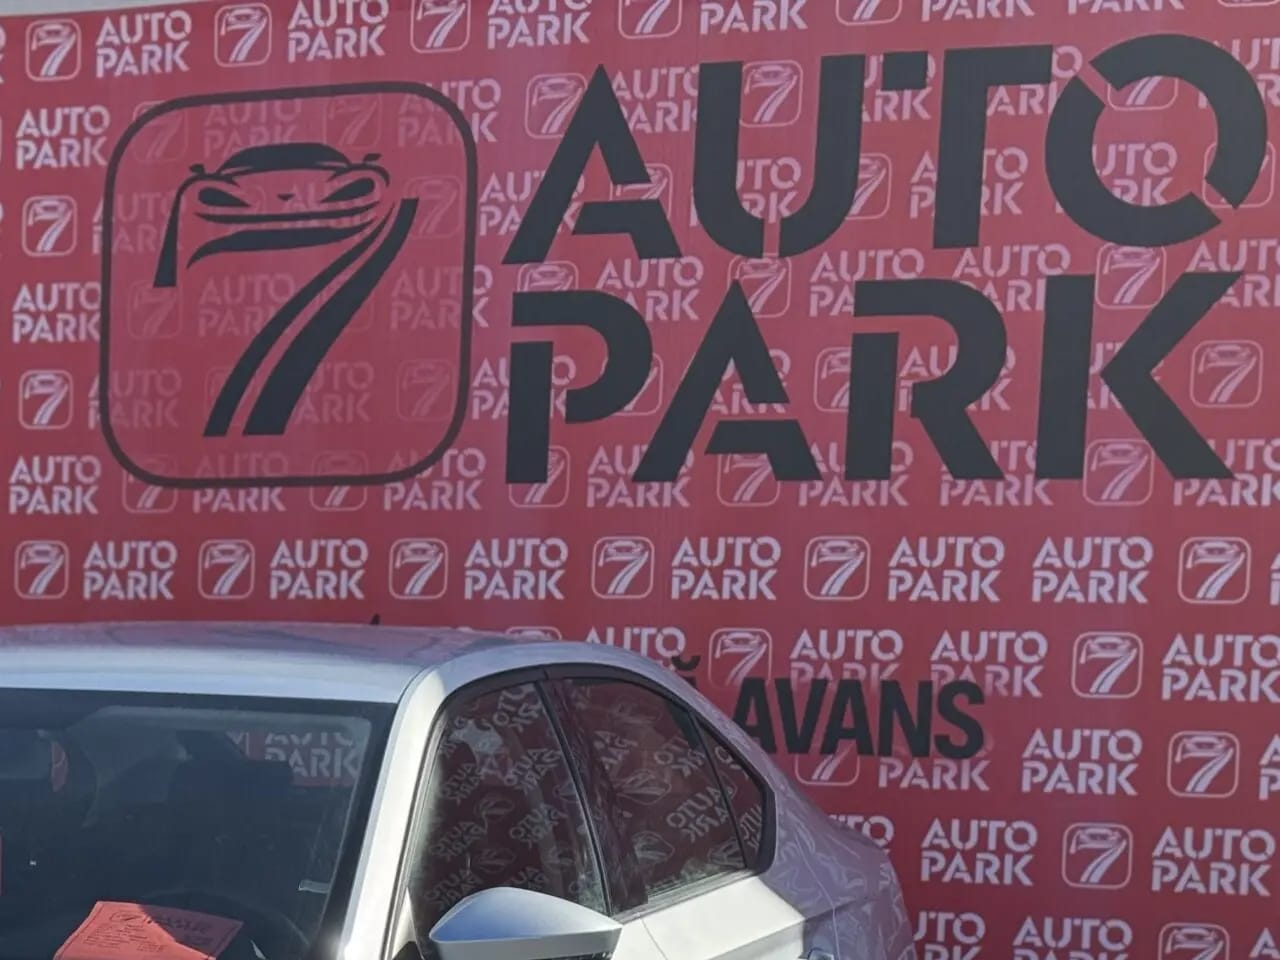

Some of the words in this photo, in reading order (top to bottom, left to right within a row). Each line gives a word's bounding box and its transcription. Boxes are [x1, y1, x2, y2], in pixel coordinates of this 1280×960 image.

[96, 11, 191, 46] AUTO
[288, 0, 388, 30] AUTO
[488, 12, 590, 49] PARK
[700, 0, 807, 34] PARK
[96, 41, 189, 78] PARK
[288, 25, 385, 63] PARK
[16, 105, 110, 140] AUTO
[16, 136, 107, 170] PARK
[502, 33, 1268, 264] AUTO
[1093, 141, 1177, 177] UTO
[595, 256, 703, 290] AUTO
[810, 249, 924, 282] AUTO
[952, 244, 1070, 278] AUTO
[12, 282, 101, 312] AUTO
[13, 312, 100, 343] PARK
[506, 270, 1244, 483] PARK
[9, 456, 101, 484] AUTO
[9, 485, 98, 514] PARK
[194, 488, 285, 512] PARK
[384, 480, 481, 510] PARK
[587, 477, 690, 507] PARK
[799, 475, 908, 506] PARK
[940, 474, 1053, 506] PARK
[83, 541, 177, 571] AUTO
[270, 538, 368, 568] AUTO
[464, 538, 568, 568] AUTO
[672, 536, 781, 568] AUTO
[888, 536, 1005, 568] AUTO
[1032, 536, 1153, 569] AUTO
[84, 570, 174, 598] PARK
[271, 569, 365, 598] PARK
[465, 569, 565, 600] PARK
[671, 569, 777, 600] PARK
[888, 569, 1000, 602] PARK
[1032, 570, 1149, 604] PARK
[790, 629, 903, 661] AUTO
[930, 630, 1048, 663] AUTO
[730, 677, 985, 761] AVANS
[1022, 728, 1142, 761] AUTO
[879, 757, 990, 791] PARK
[1022, 761, 1138, 795] PARK
[921, 818, 1037, 852] AUTO
[1152, 826, 1275, 862] AUTO
[921, 851, 1033, 886] PARK
[1152, 859, 1271, 896] PARK
[1013, 916, 1132, 951] AUTO
